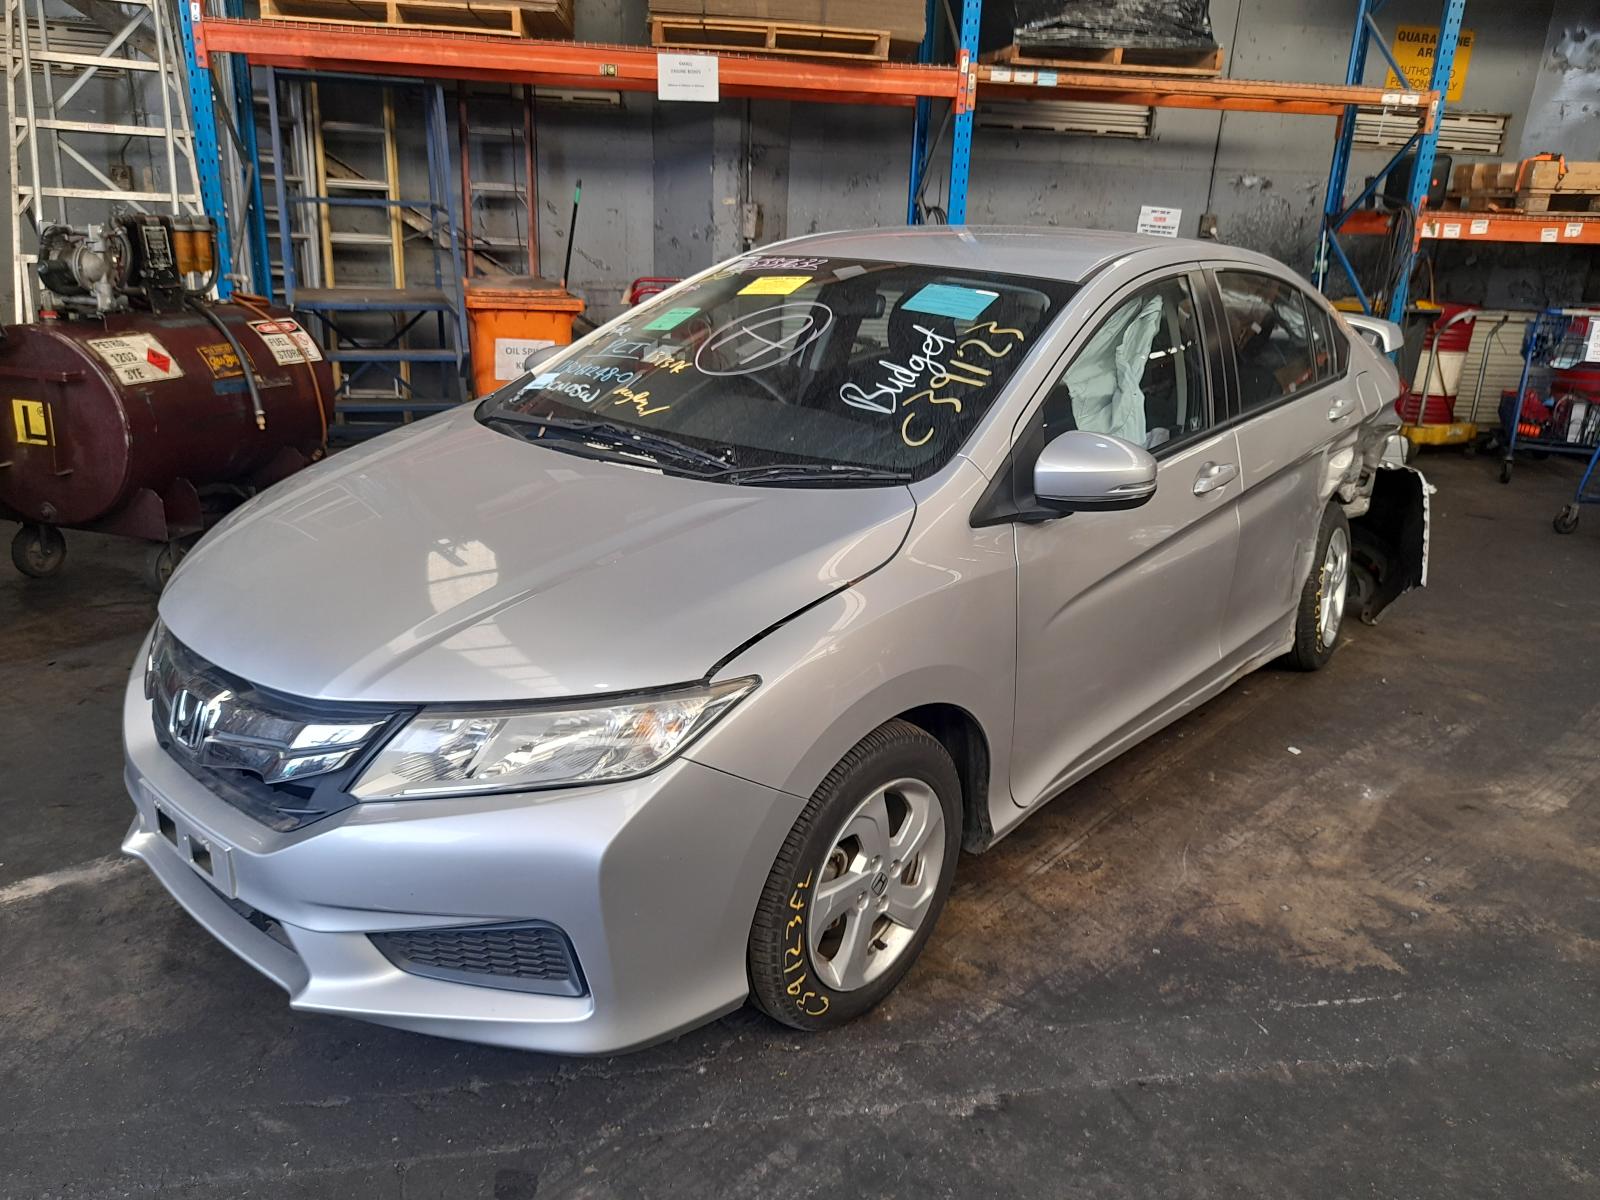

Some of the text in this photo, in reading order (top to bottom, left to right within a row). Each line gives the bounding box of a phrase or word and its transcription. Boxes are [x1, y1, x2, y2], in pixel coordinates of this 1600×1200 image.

[1398, 30, 1472, 47] QUARANE
[1401, 65, 1456, 79] AUTHOD
[92, 340, 131, 349] PETROL
[267, 337, 290, 347] FUEL
[110, 352, 138, 363] 1203
[276, 347, 313, 360] STORAE
[505, 347, 539, 355] OIL SPI
[124, 368, 145, 380] 3YE
[839, 323, 956, 414] Budget
[901, 321, 1025, 447] C39123
[22, 405, 47, 440] L
